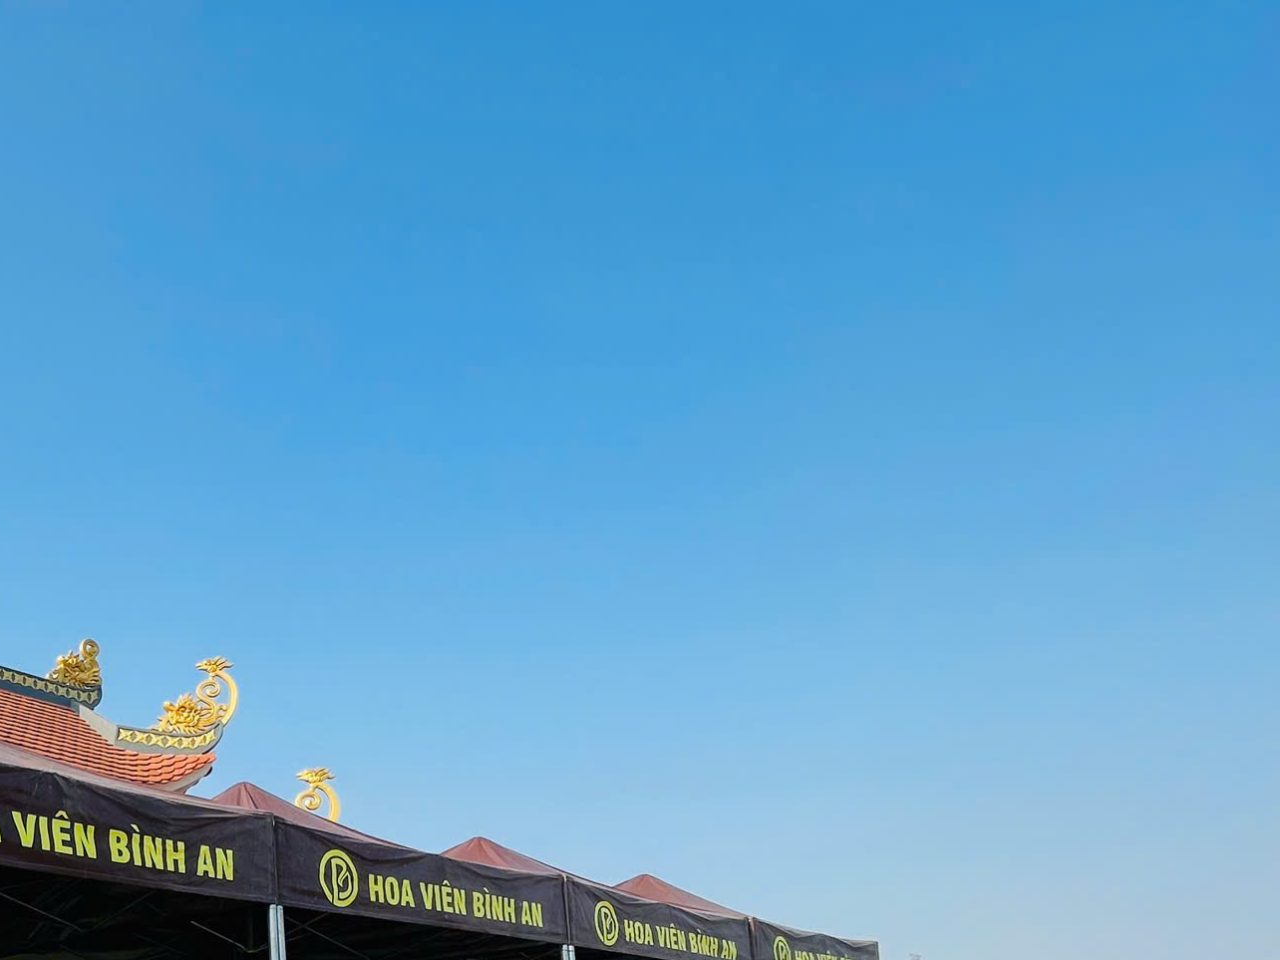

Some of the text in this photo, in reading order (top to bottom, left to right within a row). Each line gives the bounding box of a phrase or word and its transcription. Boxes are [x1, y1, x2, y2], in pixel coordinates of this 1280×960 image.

[11, 810, 97, 859] VIÊN
[109, 824, 186, 874] BÌNH
[196, 845, 234, 881] AN
[368, 873, 416, 908] HOA
[419, 880, 468, 915] VIÊN
[472, 887, 517, 923] BÌNH
[521, 901, 544, 928] AN
[623, 919, 654, 946] HOA
[655, 923, 687, 951] VIÊN
[688, 929, 718, 958] BÌNH
[720, 939, 737, 960] AN
